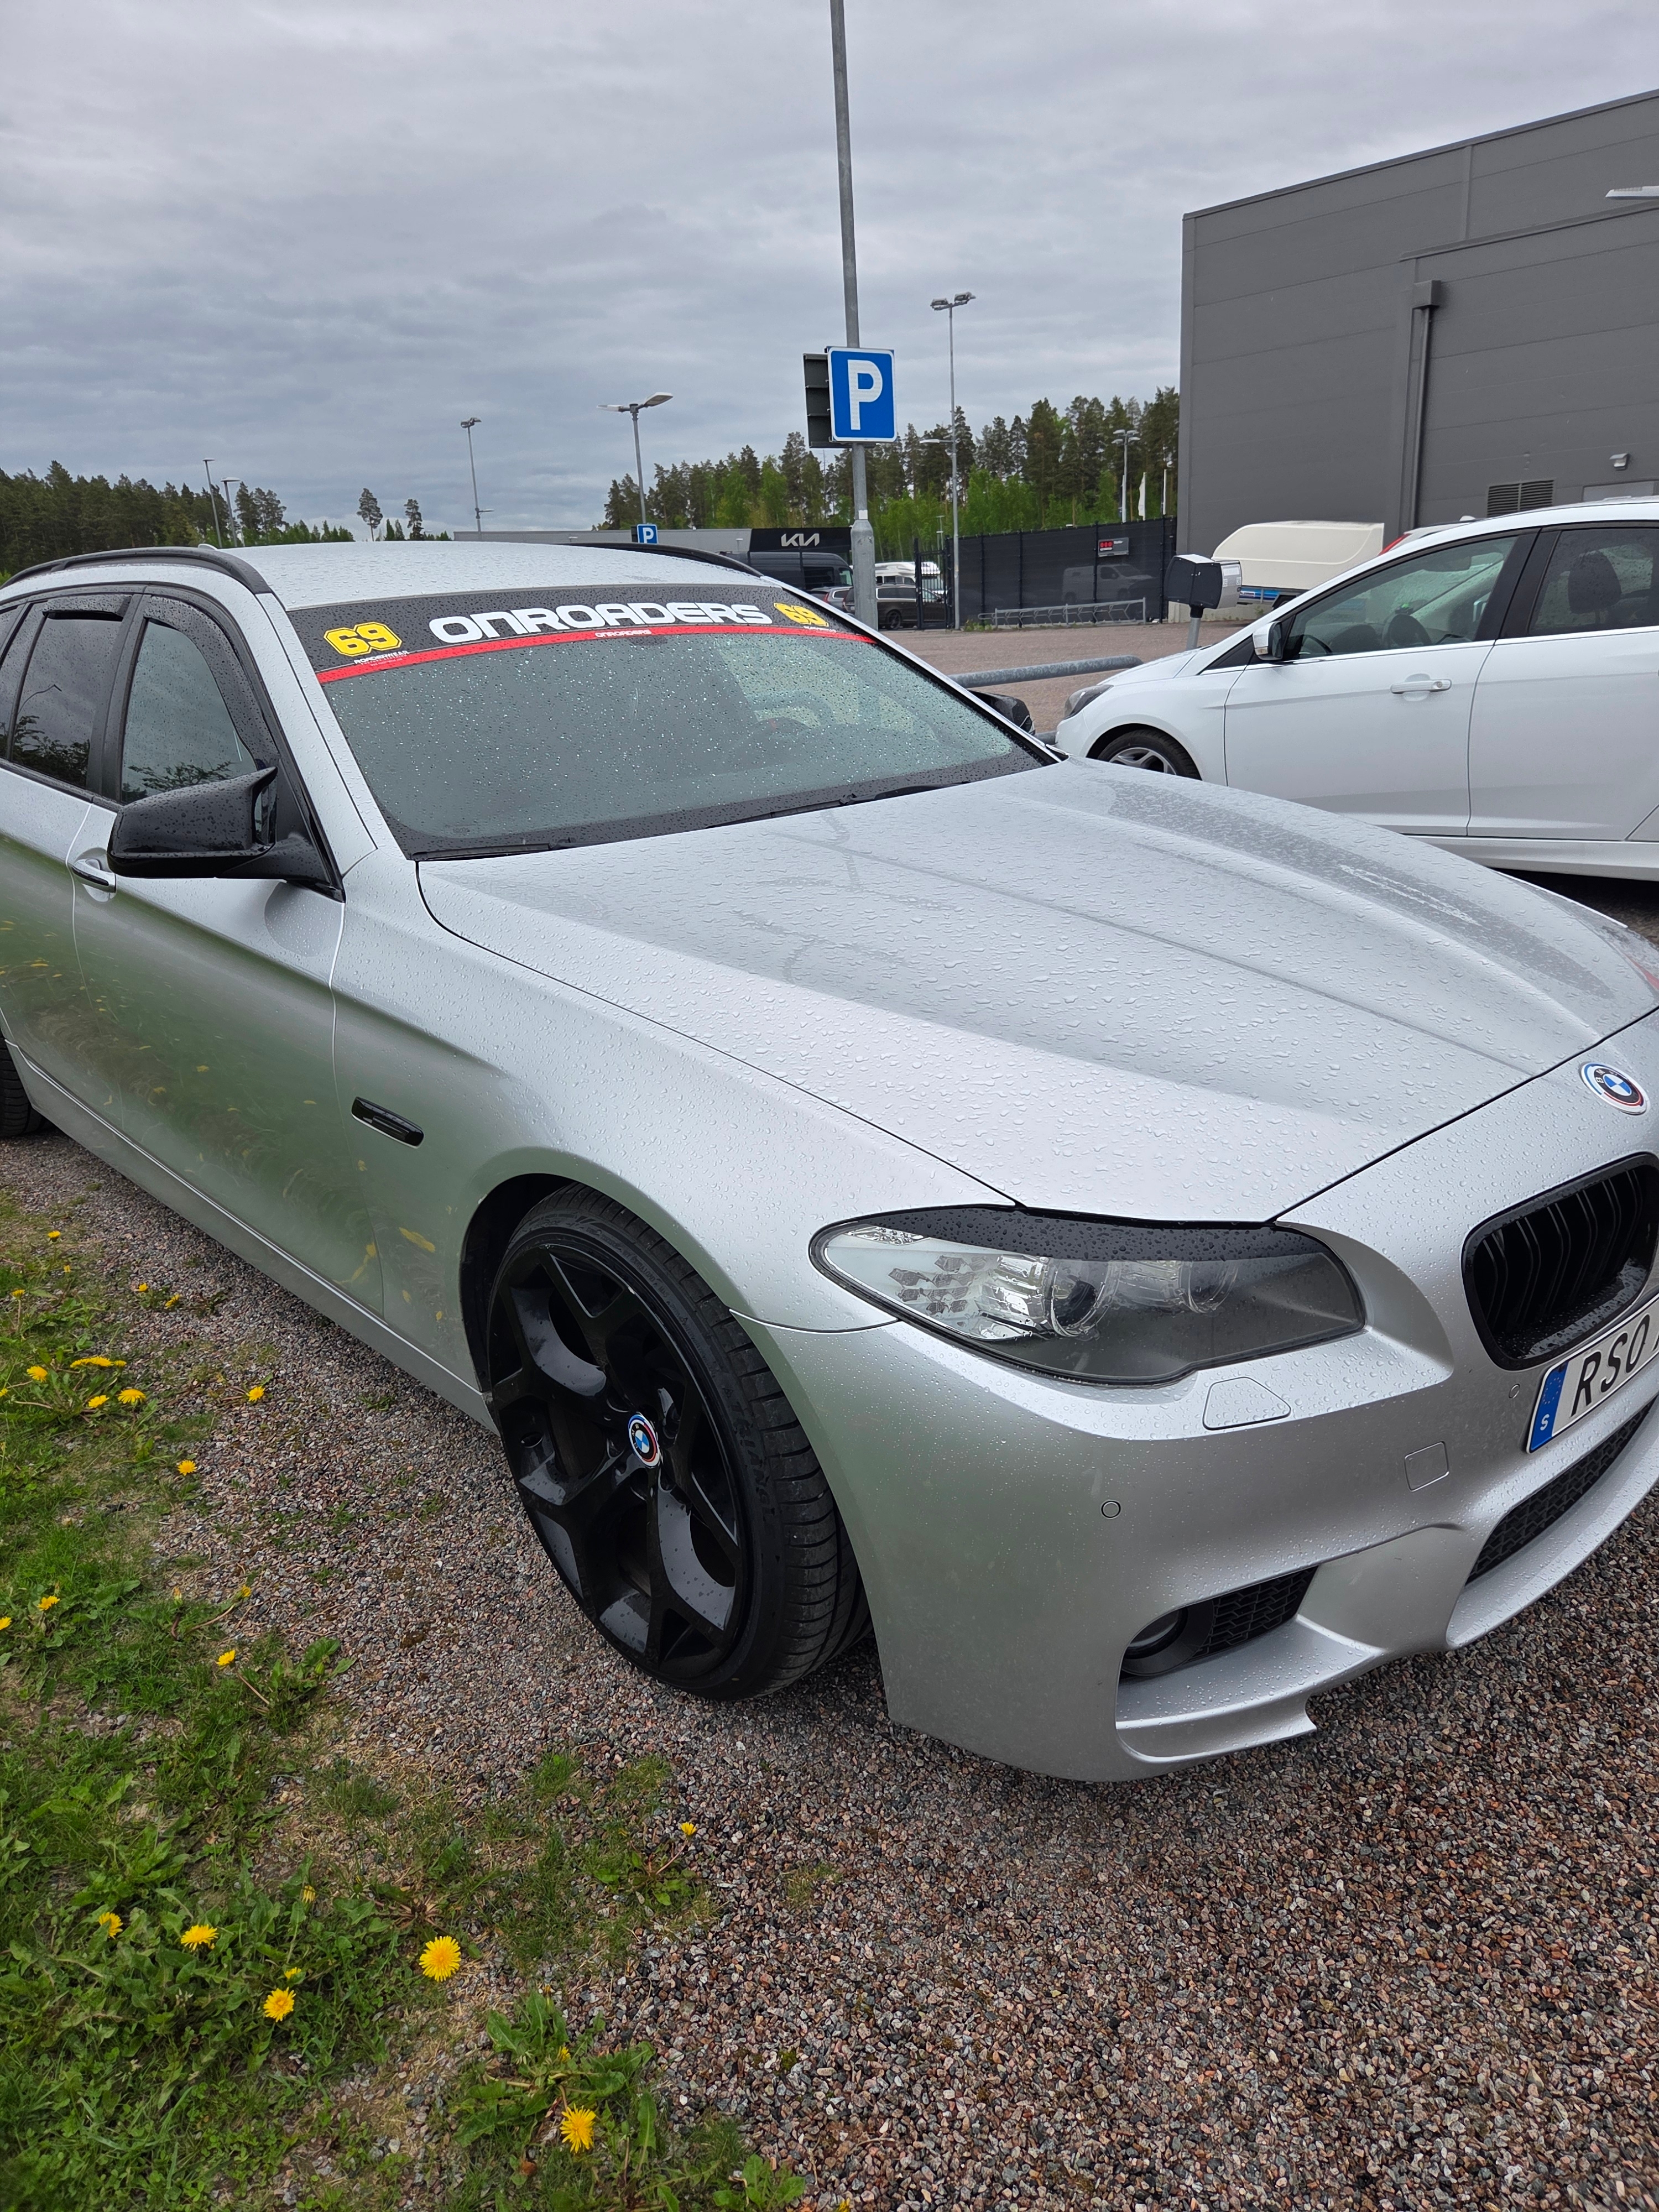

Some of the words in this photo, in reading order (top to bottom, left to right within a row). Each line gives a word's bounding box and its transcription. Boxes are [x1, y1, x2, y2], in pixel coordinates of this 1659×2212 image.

[847, 359, 883, 430] P
[643, 527, 654, 544] P
[781, 533, 820, 546] KIA
[429, 602, 773, 644] ONROADERS
[774, 602, 829, 627] 69
[324, 621, 403, 657] 69
[1571, 1314, 1650, 1417] RSO
[1540, 1414, 1550, 1431] S
